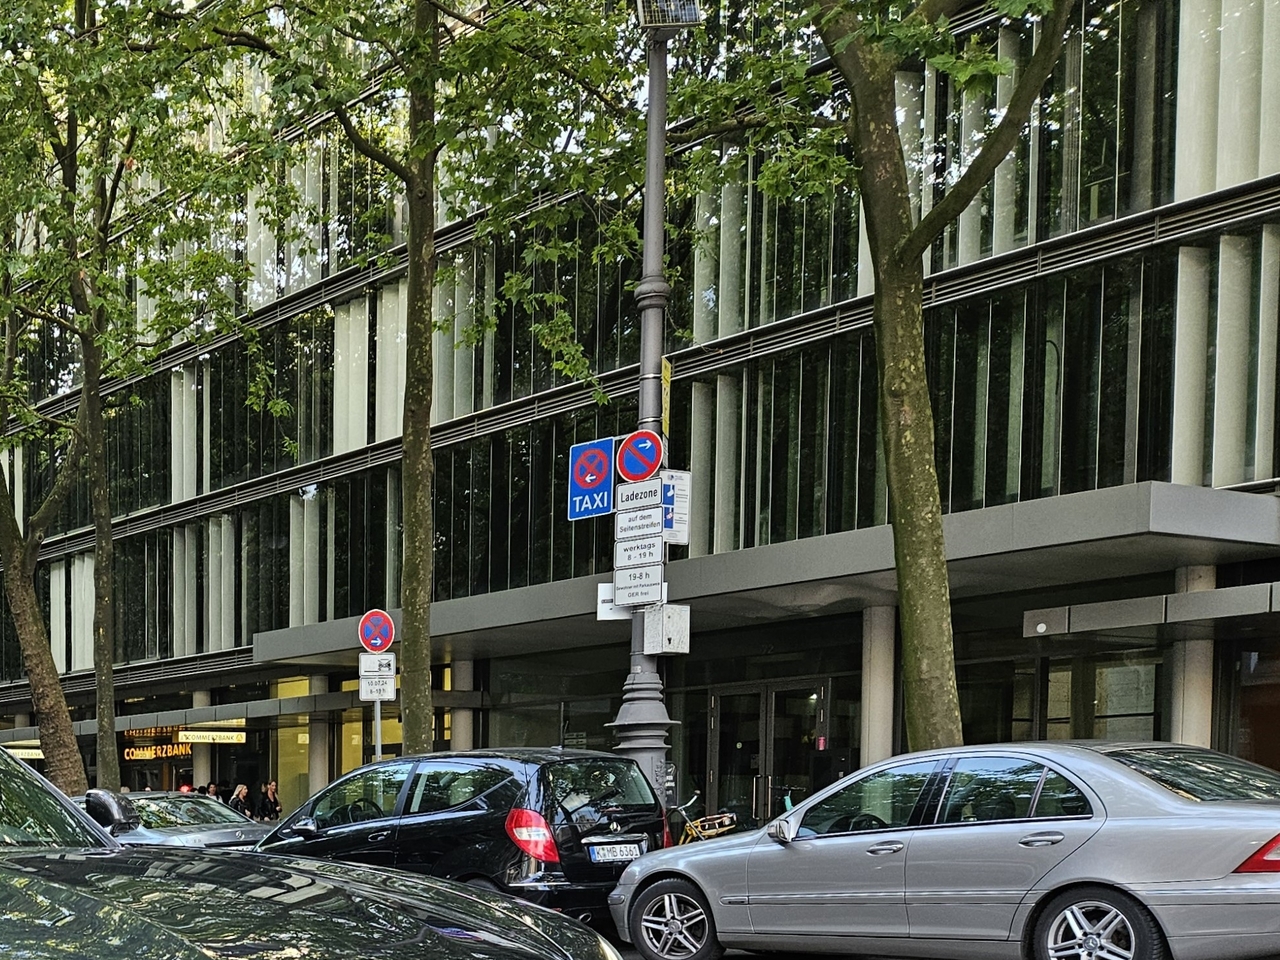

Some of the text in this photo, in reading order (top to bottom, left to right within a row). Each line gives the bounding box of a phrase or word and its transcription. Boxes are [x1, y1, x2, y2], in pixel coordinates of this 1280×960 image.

[620, 488, 658, 503] Ladezone
[573, 491, 608, 513] TAXI
[640, 513, 652, 521] dem
[619, 521, 661, 533] Seitenstreifen
[623, 542, 656, 553] werktags
[187, 734, 235, 742] COMMERZBANK
[124, 742, 192, 760] COMMERZBANK
[596, 846, 639, 859] K MB 6361
